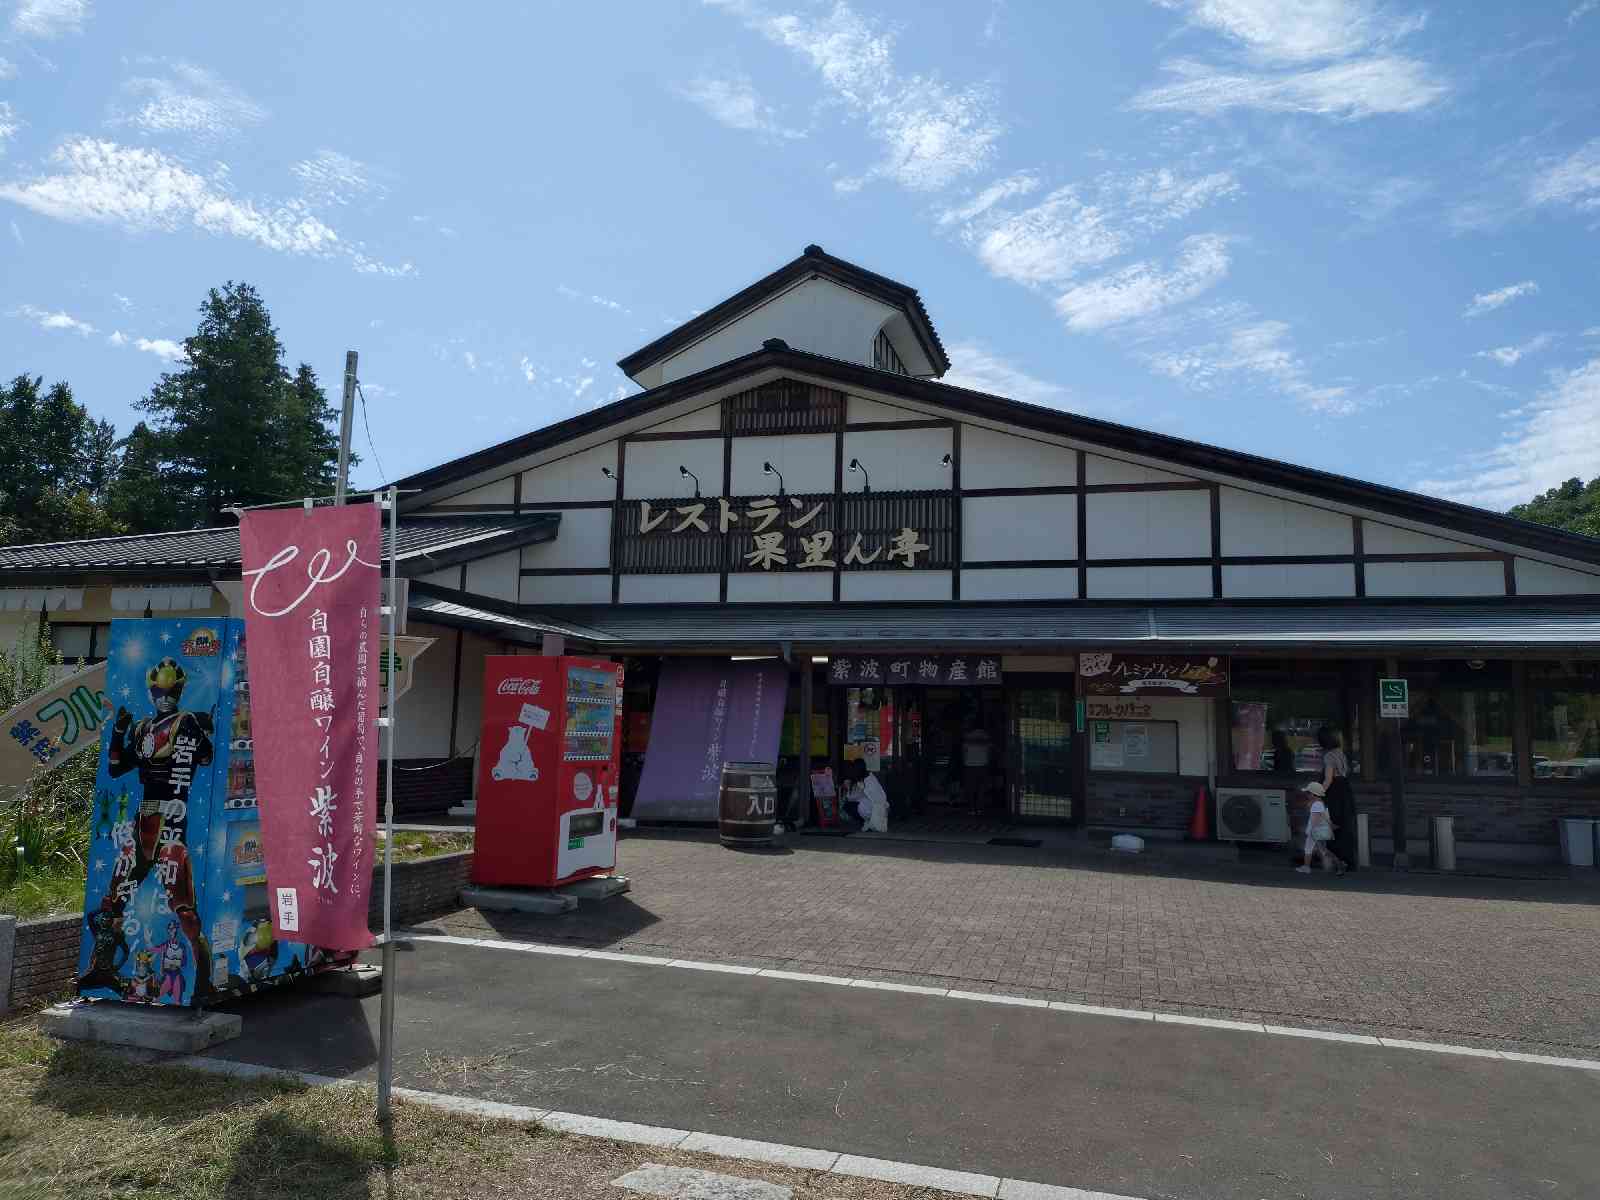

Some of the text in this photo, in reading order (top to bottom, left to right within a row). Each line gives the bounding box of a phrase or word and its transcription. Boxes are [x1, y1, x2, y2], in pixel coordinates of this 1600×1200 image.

[639, 498, 824, 534] レストラン
[745, 527, 930, 569] 果里ん亭
[831, 658, 998, 681] 紫波町物産館
[497, 678, 543, 696] Coca-Cola
[746, 793, 776, 817] 入口
